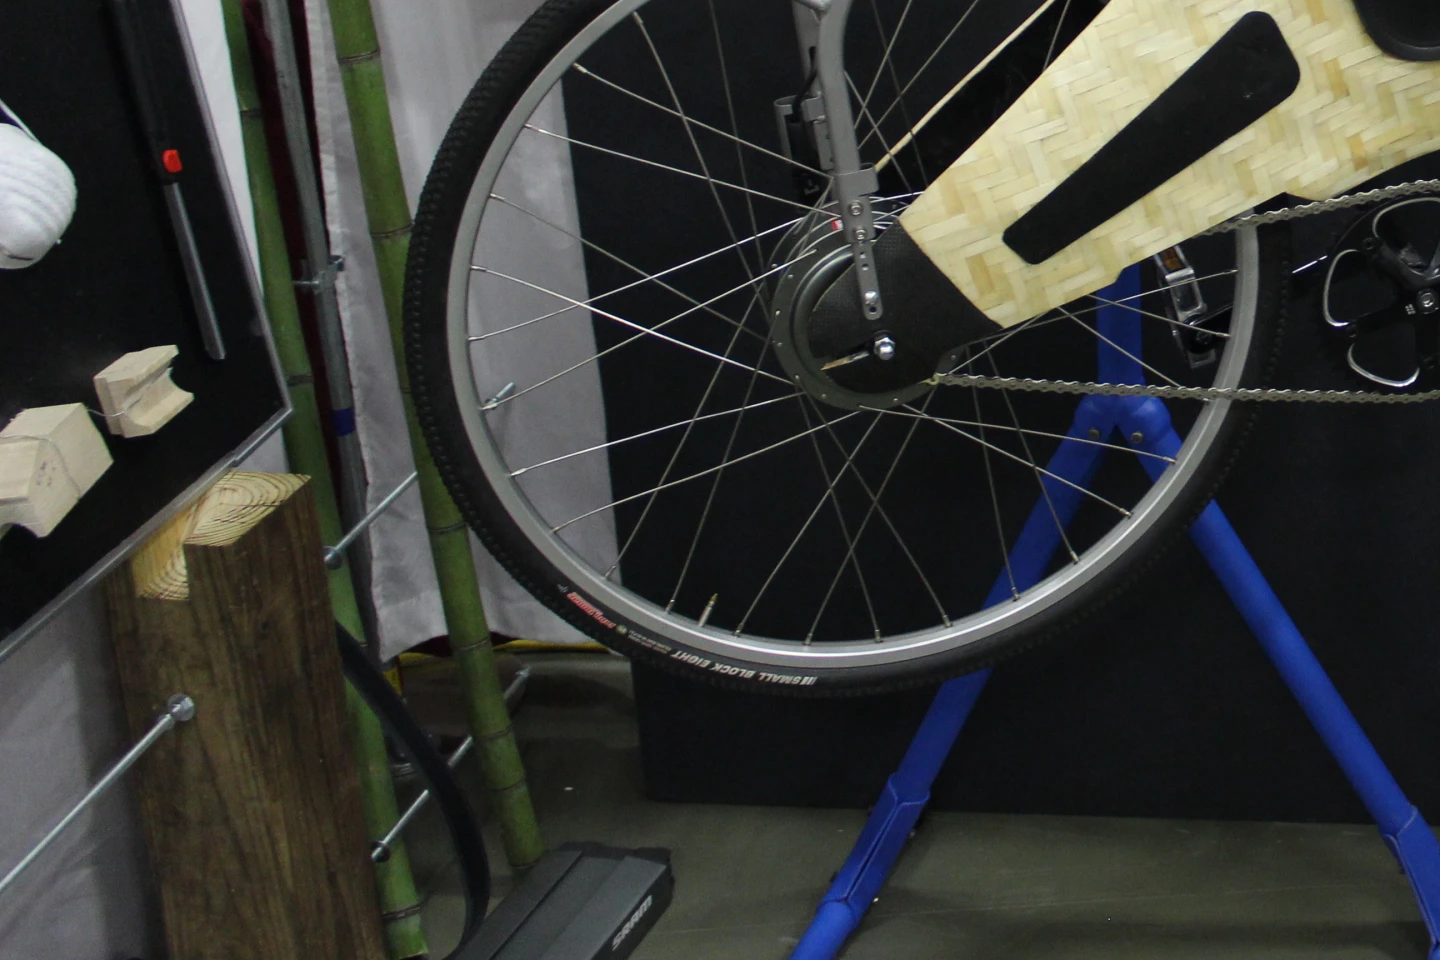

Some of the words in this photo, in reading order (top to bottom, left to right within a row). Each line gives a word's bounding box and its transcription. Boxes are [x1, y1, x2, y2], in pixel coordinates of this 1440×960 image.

[670, 650, 712, 668] EIGHT
[709, 662, 757, 679] BLOCK
[757, 671, 803, 685] SMALL
[611, 894, 654, 952] SRAM
